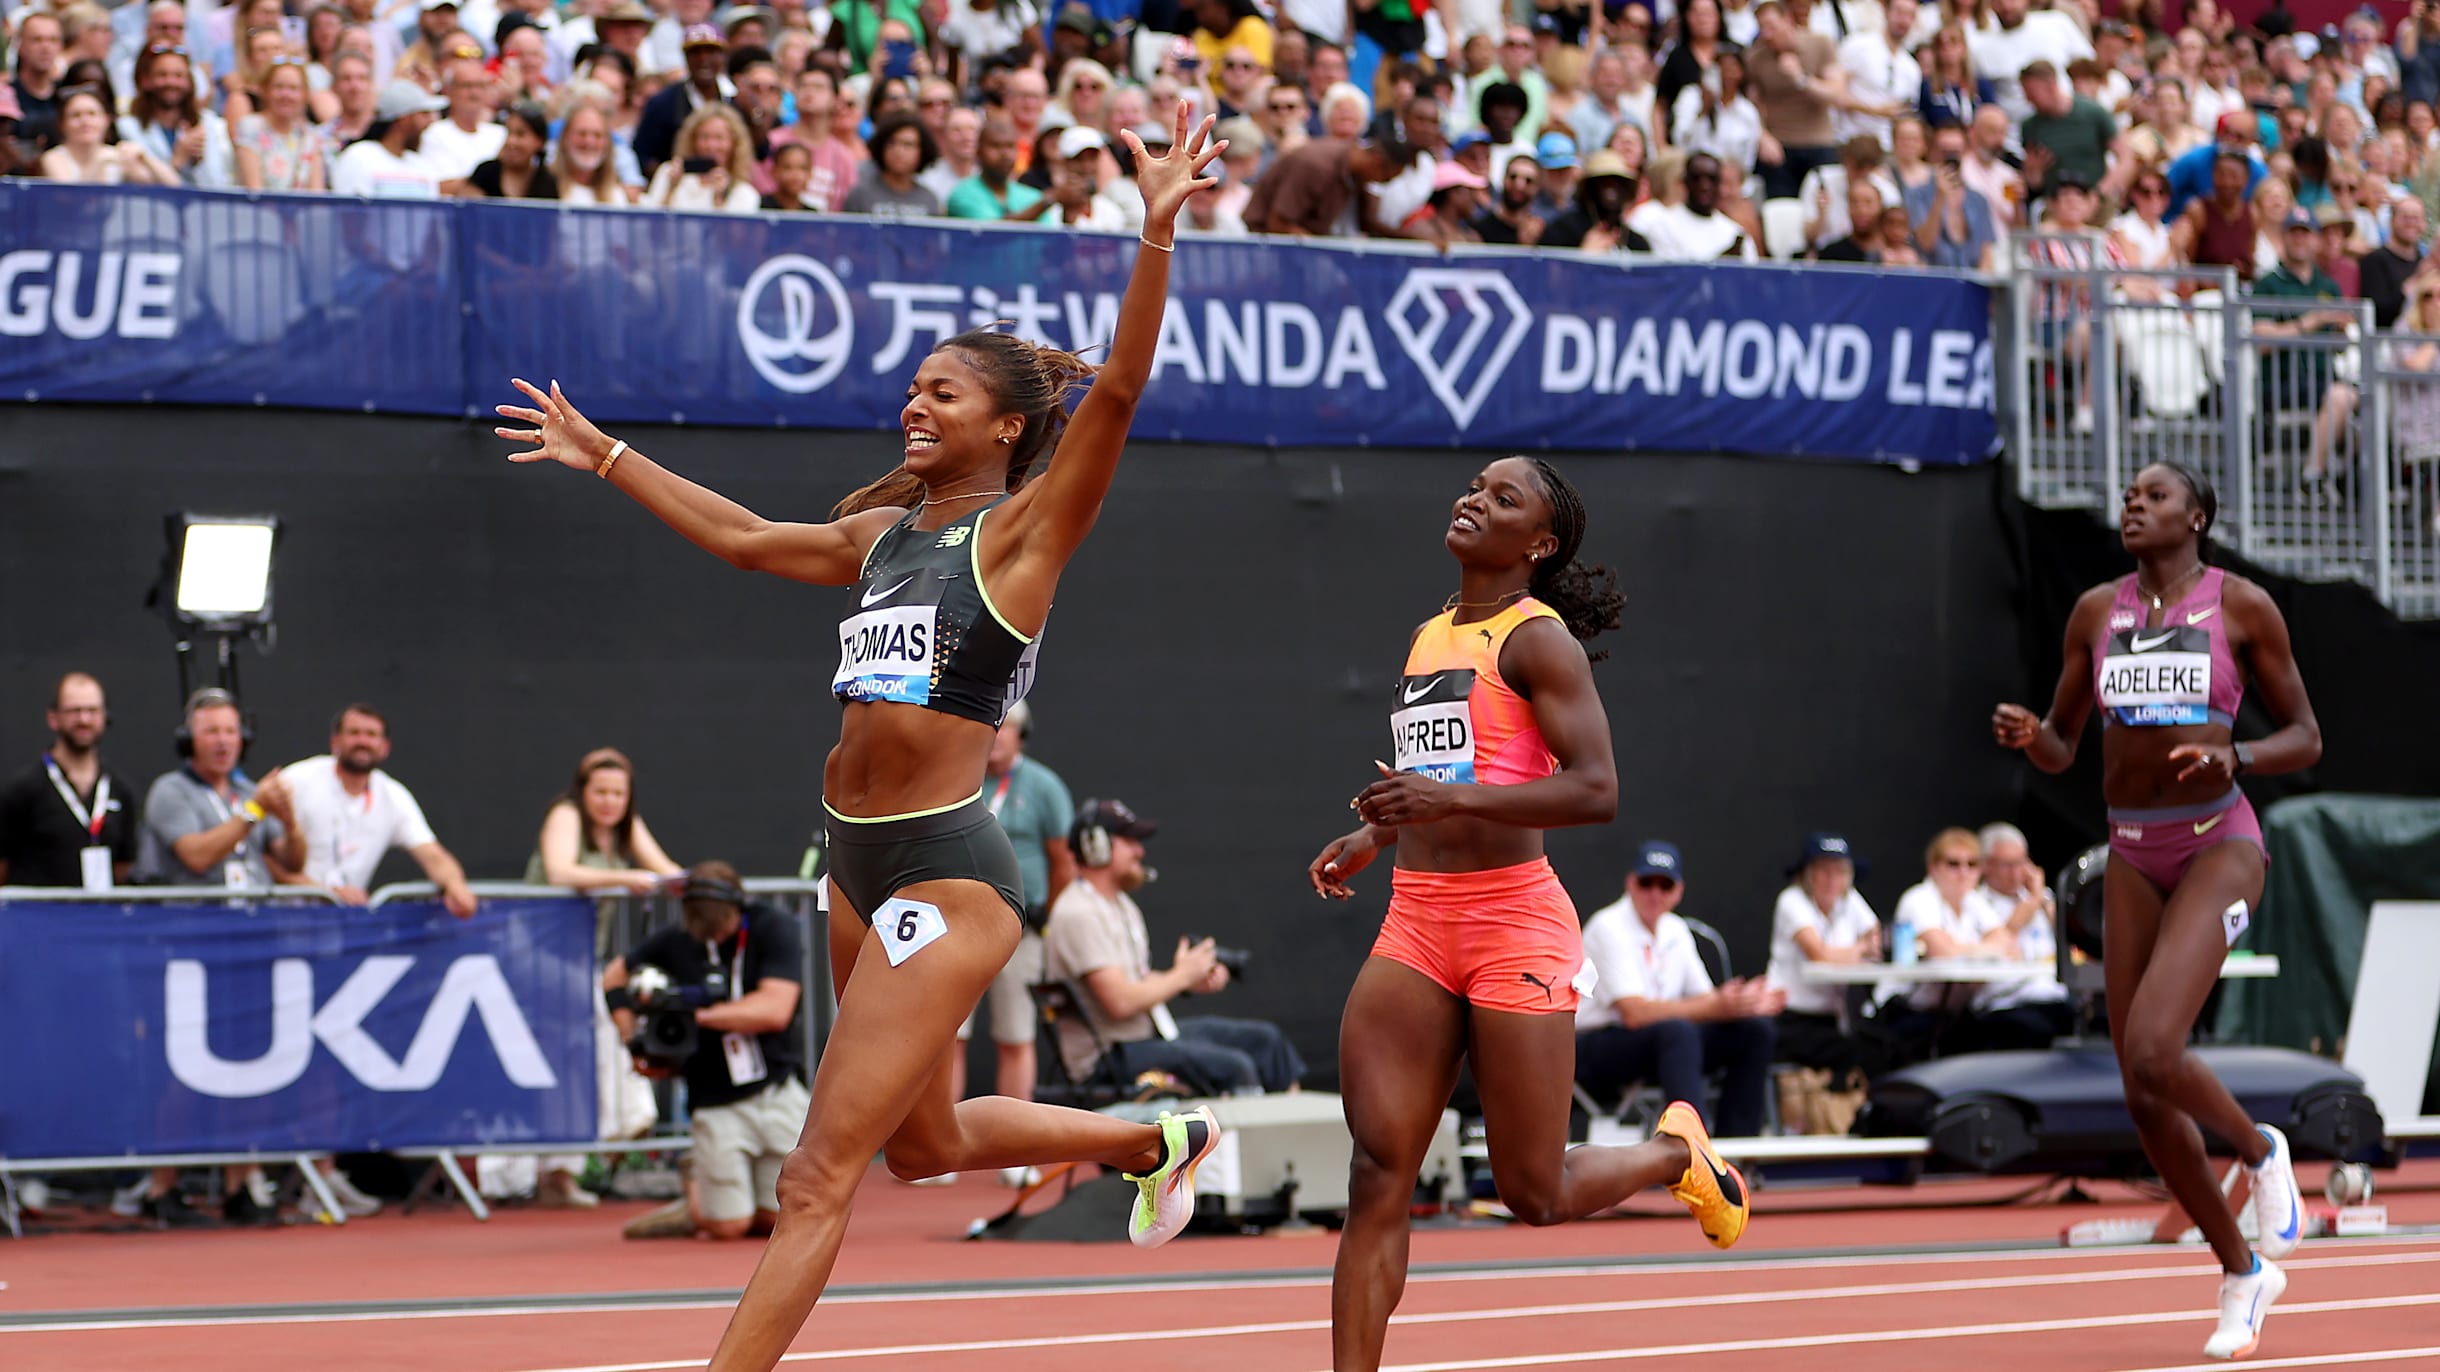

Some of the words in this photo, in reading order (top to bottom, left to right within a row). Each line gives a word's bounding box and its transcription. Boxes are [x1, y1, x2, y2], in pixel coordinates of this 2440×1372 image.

[0, 248, 183, 340] GUE
[1540, 314, 1872, 401] DIAMOND
[1886, 326, 1996, 414] LEA
[843, 623, 927, 673] THOMAS
[846, 678, 908, 697] LONDON
[2103, 666, 2204, 696] ADELEKE
[2134, 704, 2192, 722] LONDON
[1396, 716, 1467, 761] ALFRED
[896, 910, 919, 942] 6
[165, 954, 558, 1098] UKA
